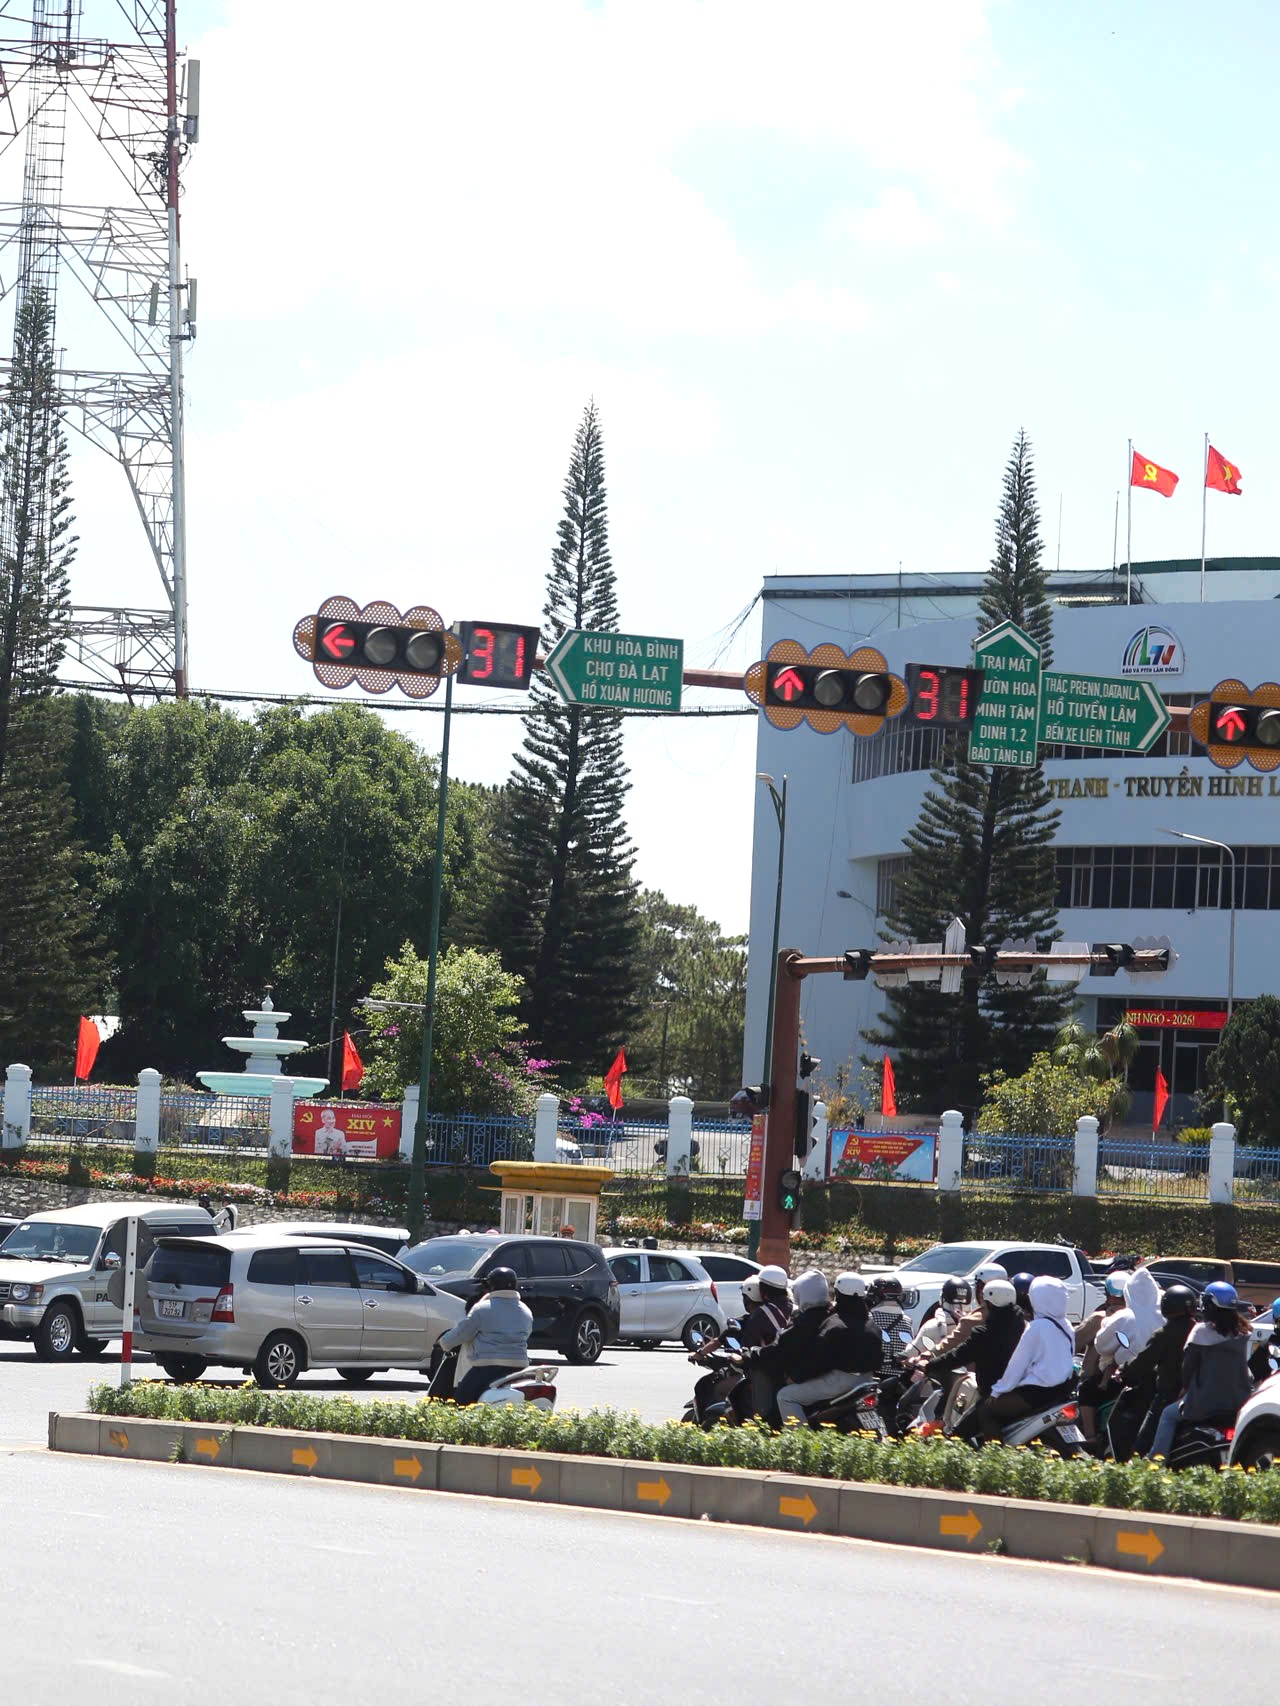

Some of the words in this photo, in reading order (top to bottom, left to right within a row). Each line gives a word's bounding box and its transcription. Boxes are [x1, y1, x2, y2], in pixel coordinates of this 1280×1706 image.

[472, 628, 525, 678] 31
[584, 638, 611, 653] KHU
[616, 638, 642, 656] HÒA
[647, 640, 678, 659] BÌNH
[586, 661, 615, 680] CHỢ
[618, 660, 637, 679] ĐÀ
[642, 665, 669, 684] LẠT
[981, 655, 1005, 672] TRẠI
[1008, 655, 1032, 673] MÁT
[581, 680, 597, 699] HỒ
[600, 683, 630, 701] XUÂN
[633, 688, 672, 705] HƯƠNG
[983, 677, 1009, 695] ƯỜN
[1013, 682, 1037, 696] HOA
[1045, 676, 1068, 693] THÁC
[917, 671, 969, 720] 31
[975, 703, 1006, 718] MINH
[1010, 704, 1035, 720] TÂM
[1047, 696, 1064, 715] HỒ
[1068, 700, 1107, 720] TUYỀN
[1111, 705, 1137, 723] LÂM
[980, 725, 1007, 740] DINH
[1045, 721, 1064, 740] BẾN
[1066, 727, 1078, 742] XE
[1080, 725, 1102, 743] LIÊN
[1106, 725, 1131, 746] TỈNH
[971, 743, 991, 760] BẢO
[993, 745, 1018, 762] TÀNG
[1047, 777, 1109, 799] THANH
[1124, 765, 1204, 797] TRUYỀN
[1207, 770, 1264, 797] HÌNH
[347, 1118, 376, 1131] XIV
